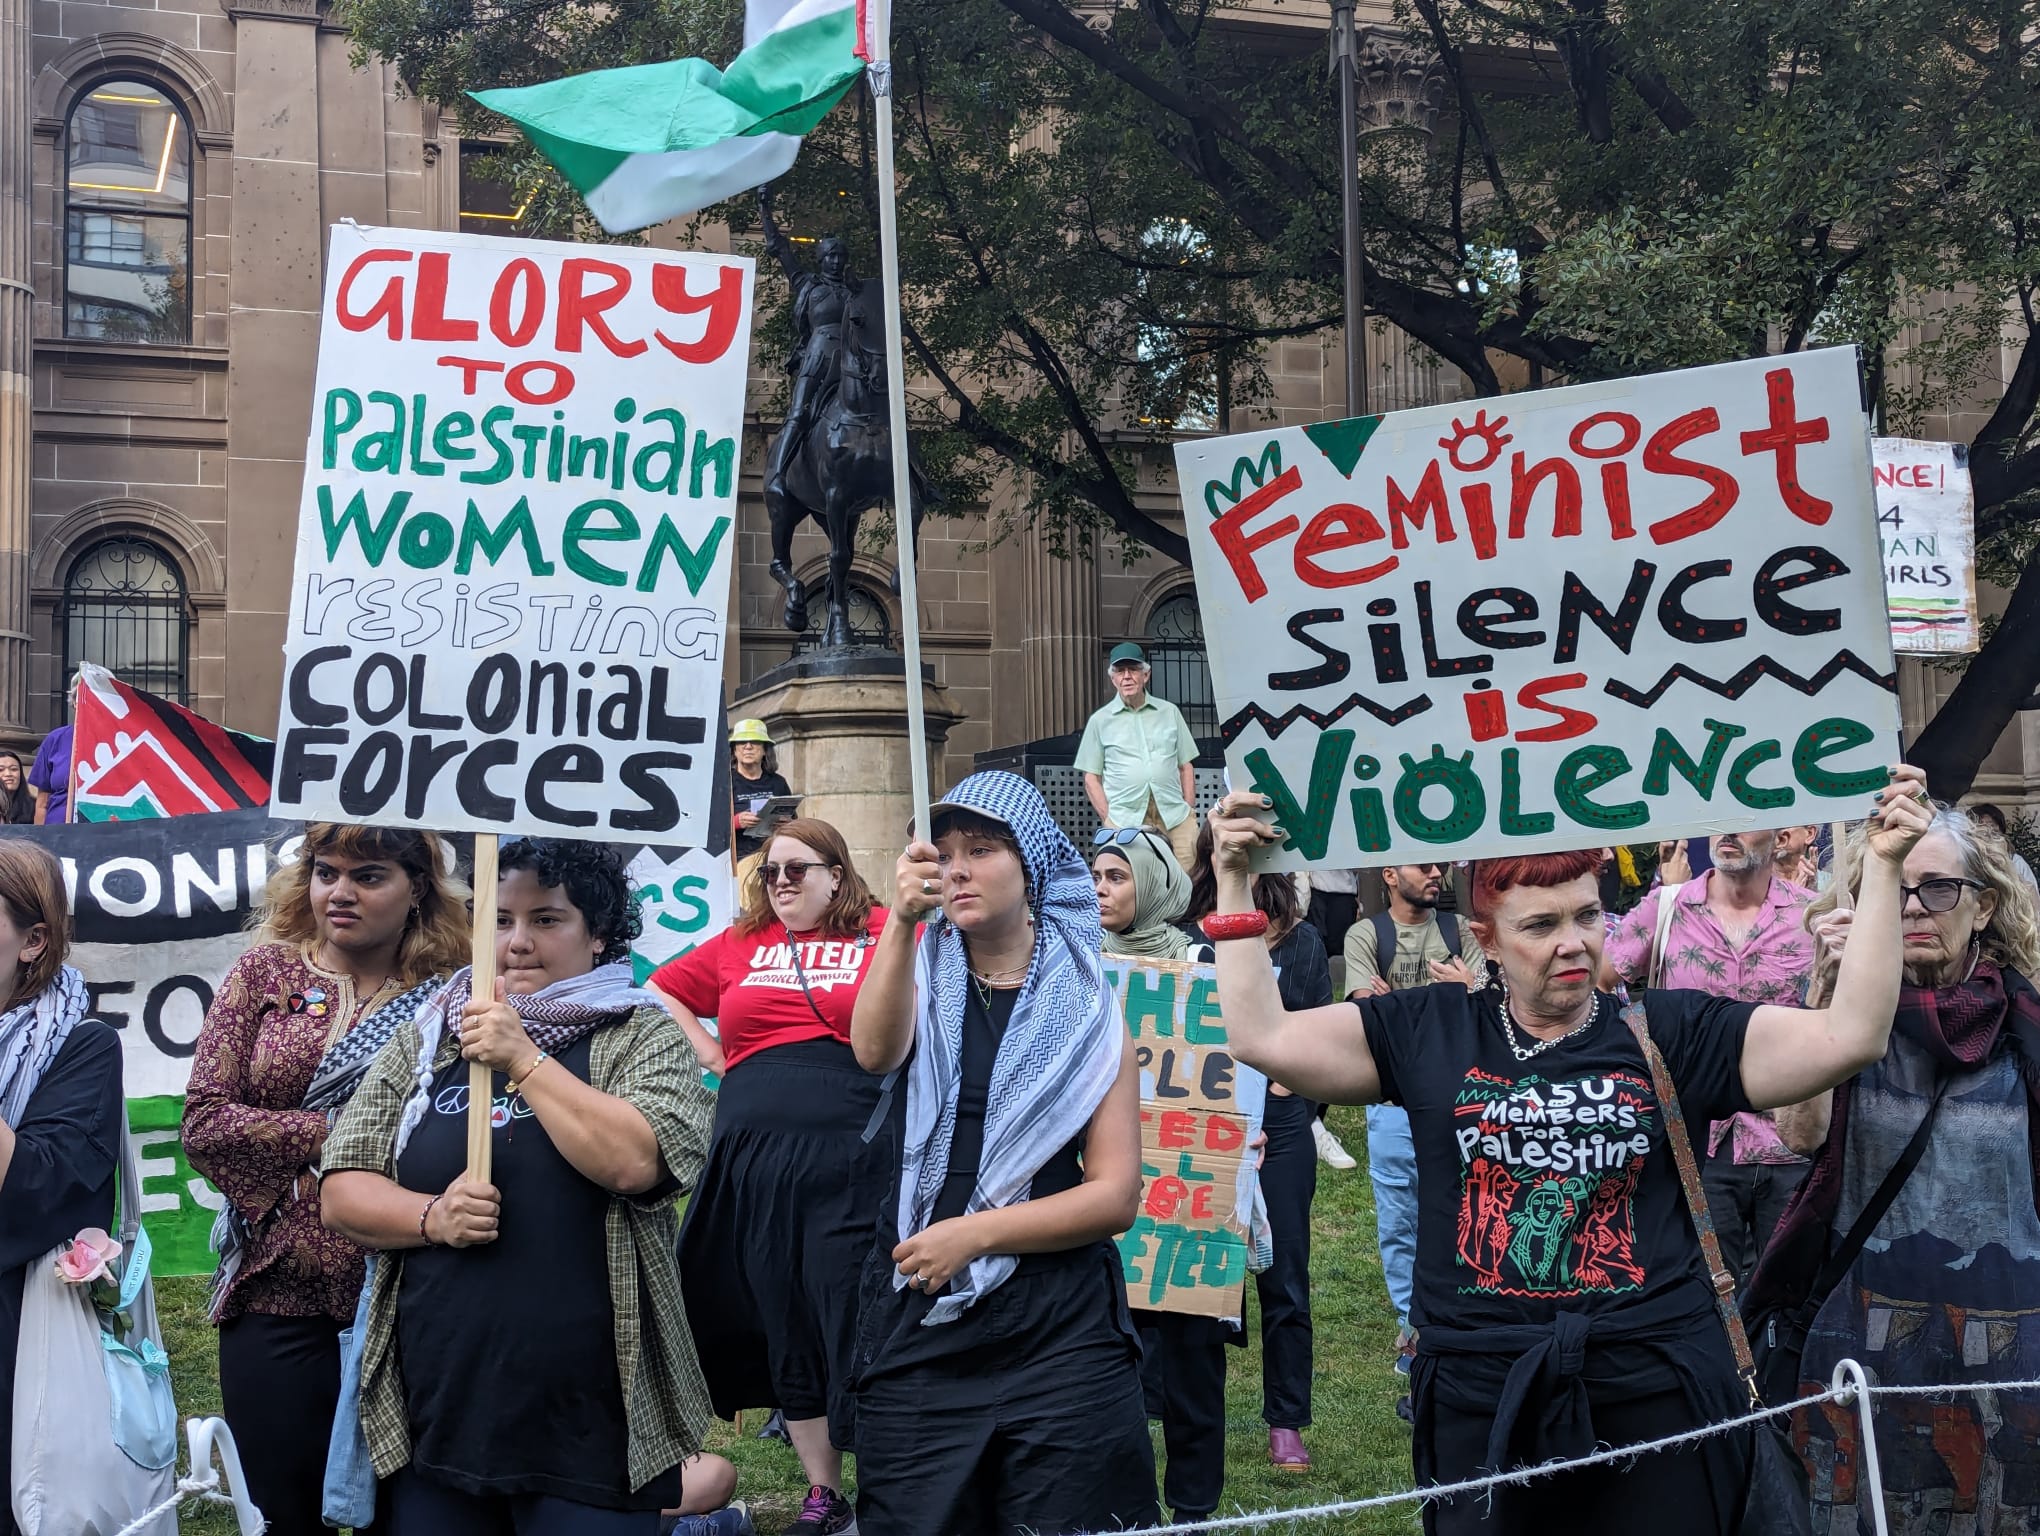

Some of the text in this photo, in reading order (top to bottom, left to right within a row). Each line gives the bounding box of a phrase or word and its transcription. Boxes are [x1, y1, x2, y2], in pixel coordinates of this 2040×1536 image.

[336, 249, 744, 364] GLORY
[437, 356, 575, 405] TO
[1884, 564, 1952, 587] IRLS
[60, 835, 306, 918] IONI
[749, 941, 866, 970] UNITED
[748, 973, 809, 985] WORKER
[1509, 1078, 1615, 1107] ASU
[1140, 1110, 1244, 1151] ED
[1515, 1126, 1568, 1139] FOR
